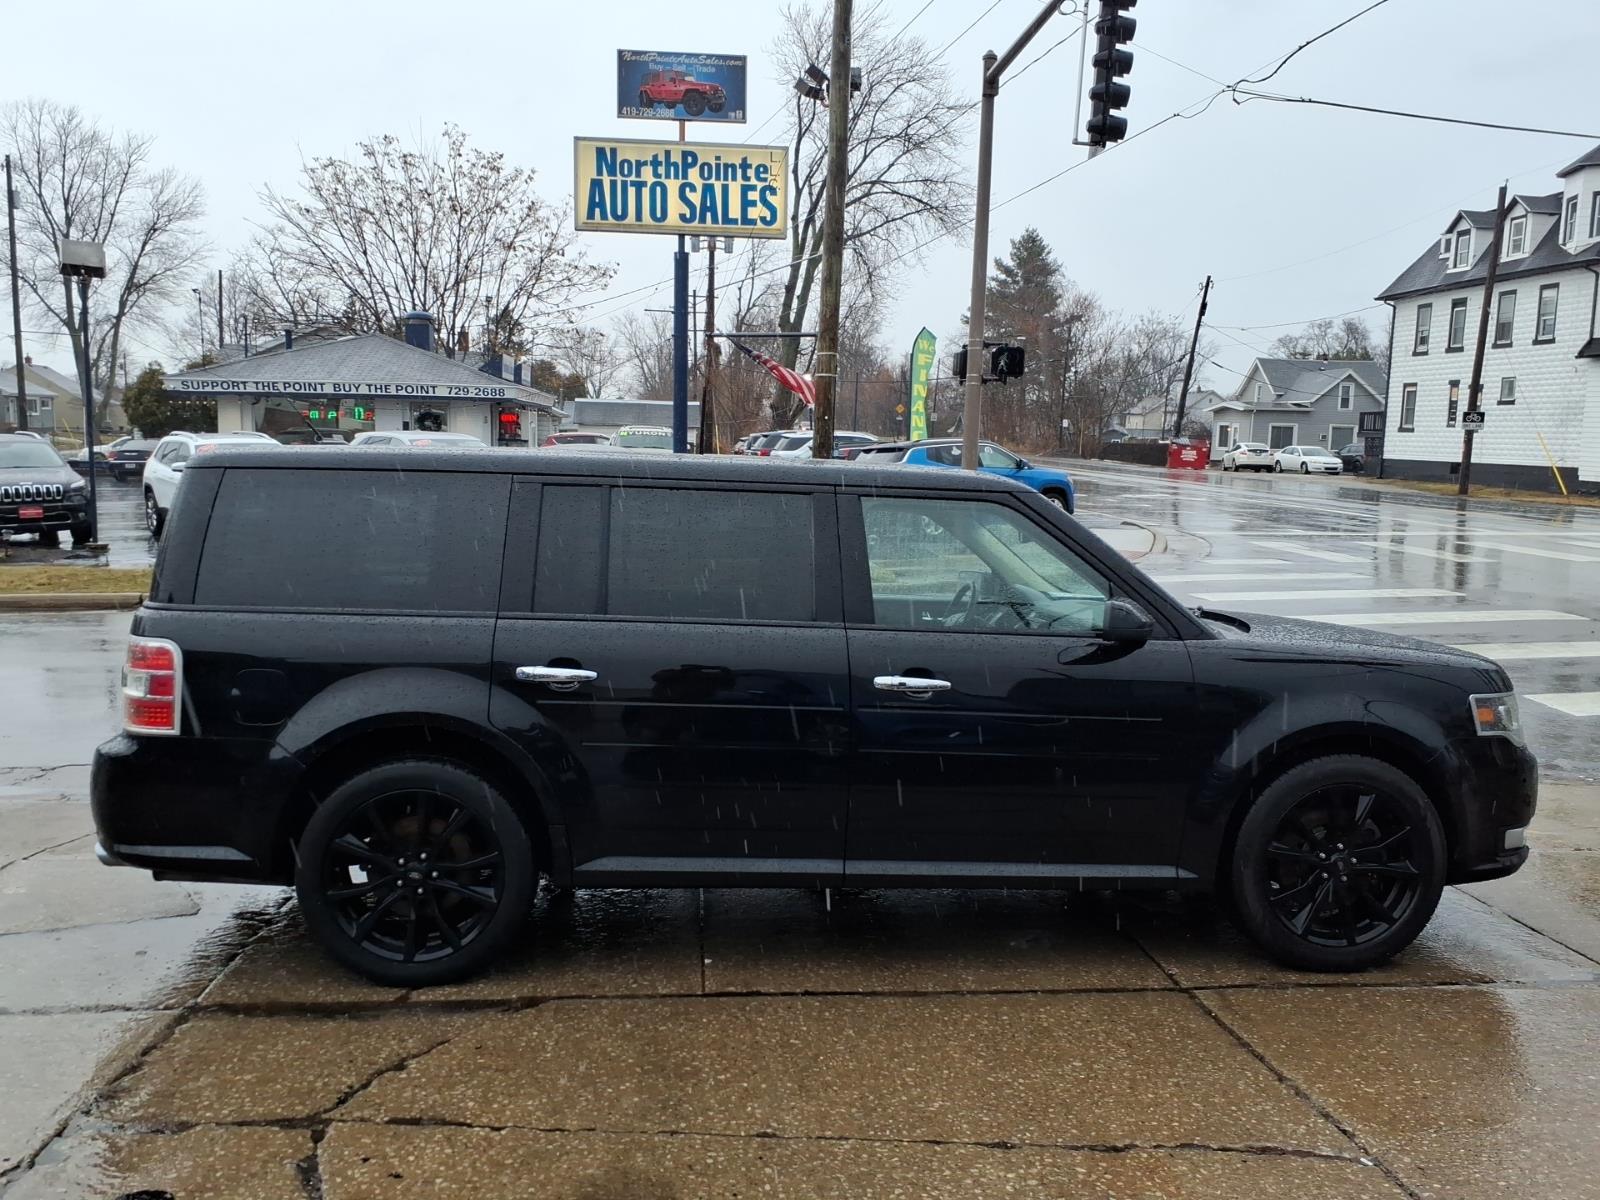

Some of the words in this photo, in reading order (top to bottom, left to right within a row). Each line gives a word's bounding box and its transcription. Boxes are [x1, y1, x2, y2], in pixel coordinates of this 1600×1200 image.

[622, 52, 743, 66] NorthPointeAutoSales.com
[649, 63, 664, 71] Buy
[696, 65, 716, 73] Trade
[621, 107, 675, 118] 419-729-2688
[595, 147, 769, 182] NorthPointe
[586, 178, 669, 223] AUTO
[678, 181, 778, 227] SALES
[919, 341, 935, 352] We
[181, 380, 249, 391] SUPPORT
[254, 381, 280, 392] THE
[283, 382, 326, 392] POINT
[333, 383, 362, 393] BUY
[365, 384, 392, 394] THE
[395, 385, 438, 395] POINT
[447, 386, 506, 397] 729-2688
